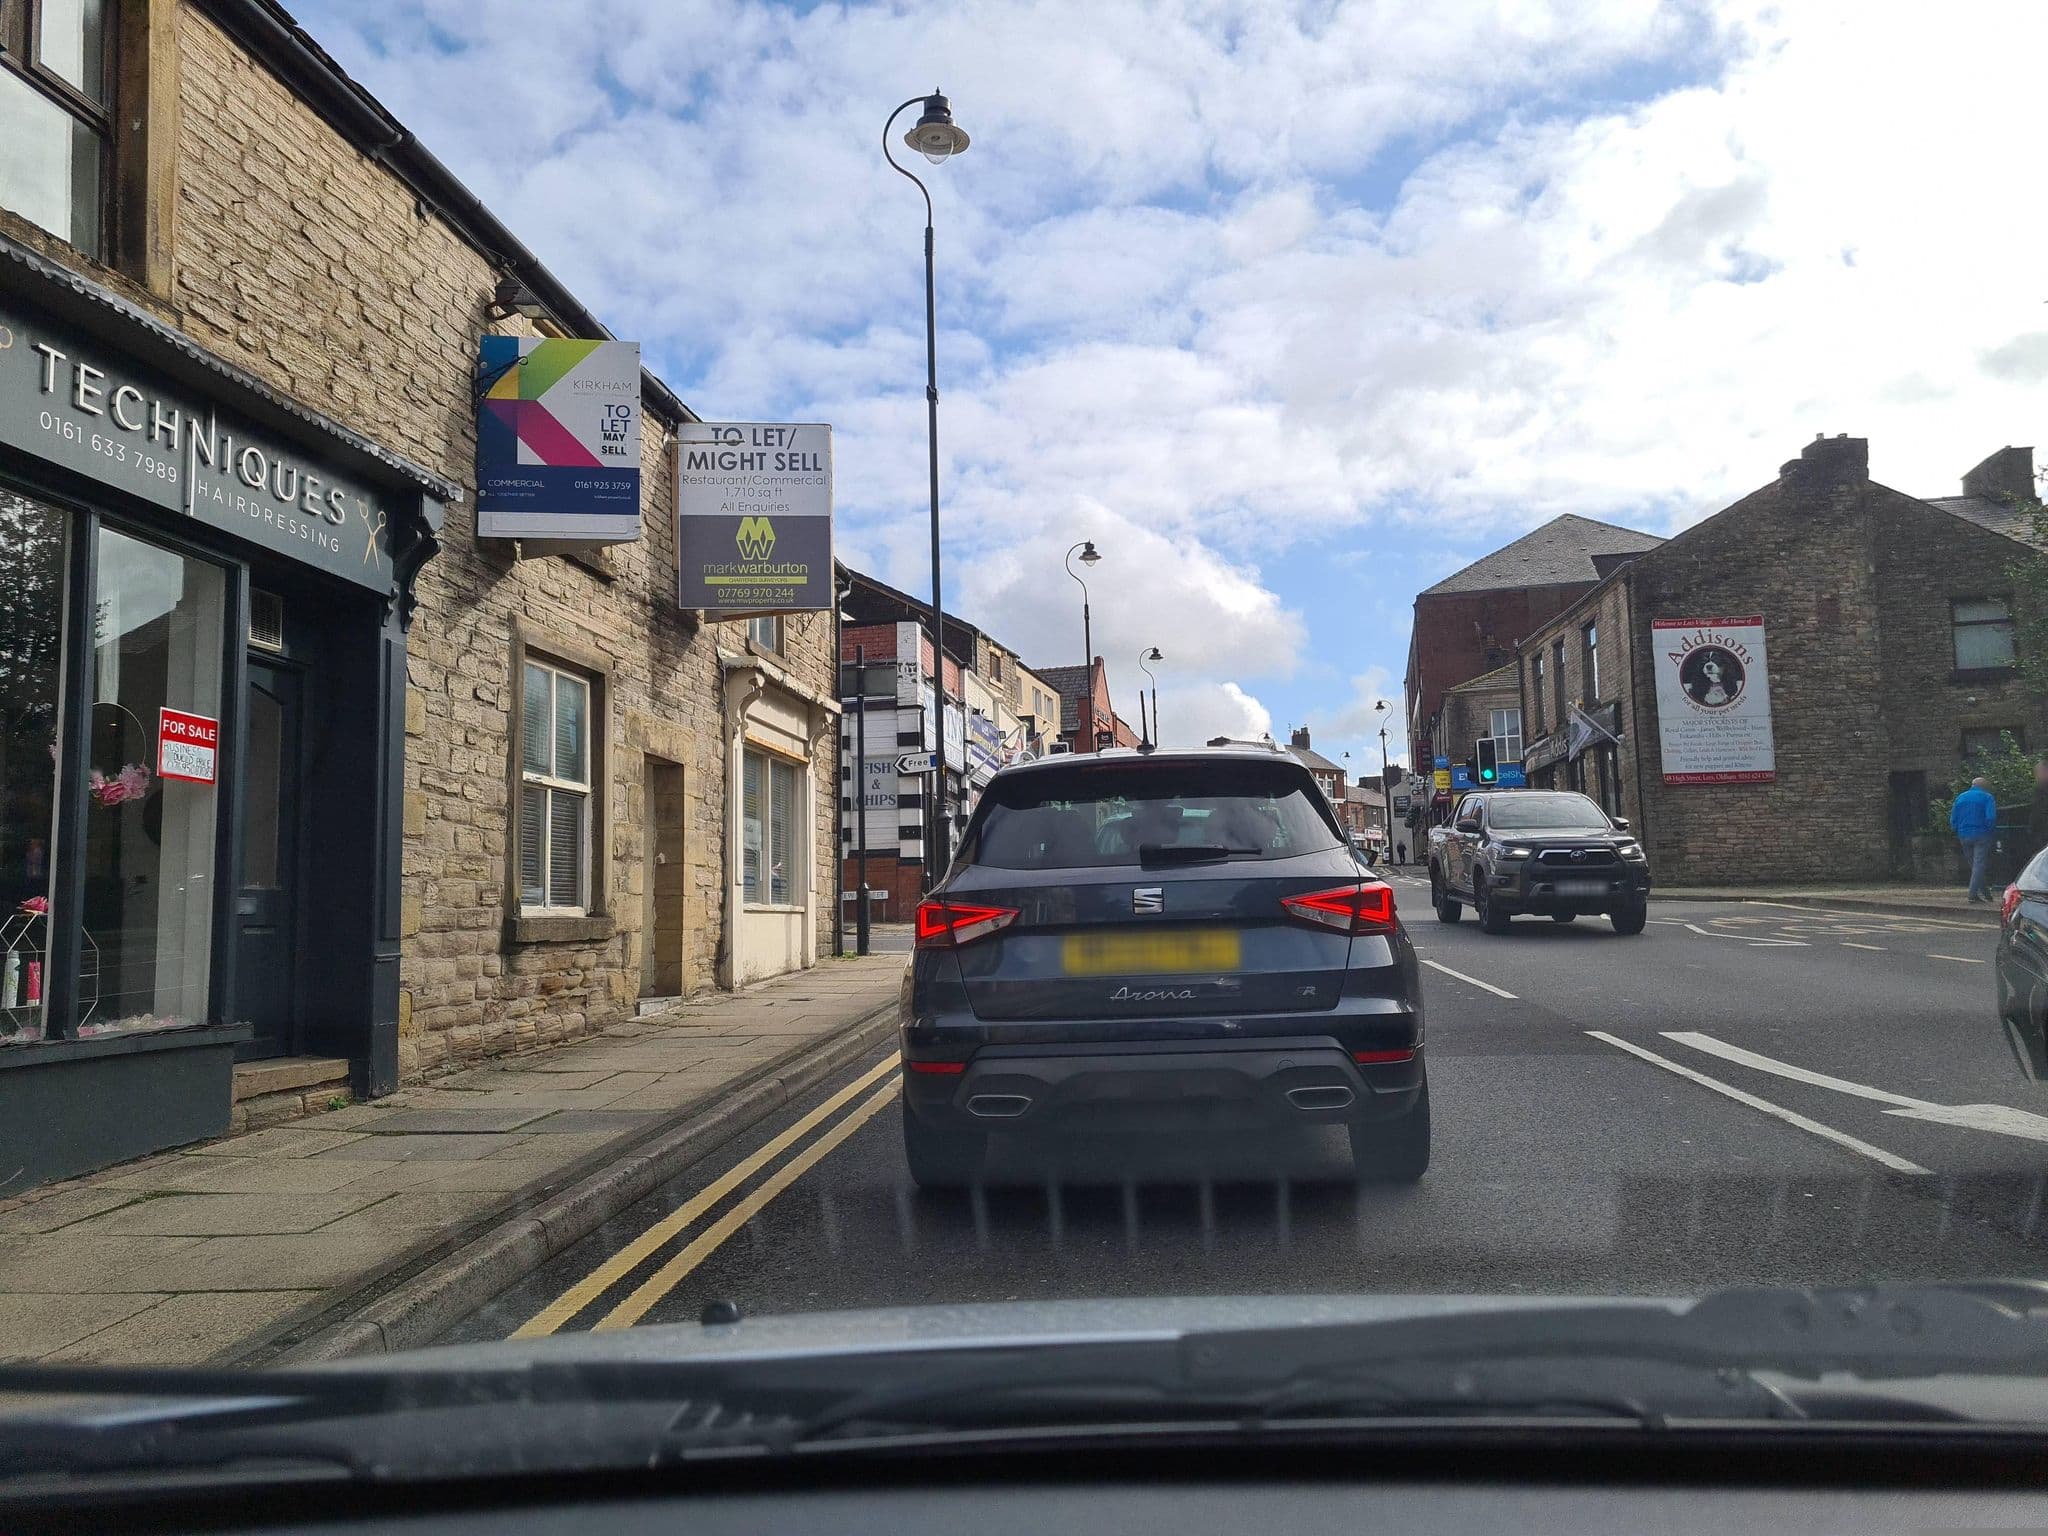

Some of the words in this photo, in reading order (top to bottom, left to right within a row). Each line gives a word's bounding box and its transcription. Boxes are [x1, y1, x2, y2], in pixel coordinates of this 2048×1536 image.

[573, 380, 632, 391] KIRKHAM
[604, 404, 631, 418] TO
[601, 418, 631, 433] LET
[38, 342, 345, 524] TECHNIQUES
[603, 433, 626, 442] MAY
[711, 427, 743, 446] TO
[752, 428, 797, 450] LET/
[40, 411, 82, 444] 0161
[91, 434, 126, 462] 633
[134, 451, 177, 483] 7989
[601, 445, 627, 455] SELL
[686, 451, 767, 471] MIGHT
[774, 453, 823, 471] SELL
[487, 479, 545, 488] COMMERCIAL
[574, 480, 592, 489] 0161
[594, 481, 610, 490] 925
[612, 481, 631, 490] 3759
[682, 475, 826, 486] Restaurant/Commercial
[758, 488, 771, 498] sq
[775, 488, 783, 497] ft
[720, 502, 735, 512] All
[738, 502, 790, 513] Enquiries
[198, 479, 340, 553] HAIRDRESSING
[703, 562, 808, 574] markwarburton
[717, 588, 750, 598] 07769
[752, 588, 773, 598] 970
[775, 588, 794, 598] 244
[1668, 629, 1754, 667] Addisons
[162, 719, 186, 736] FOR
[188, 724, 216, 742] SALE
[908, 759, 928, 767] Free
[871, 778, 881, 790] &
[857, 794, 897, 806] HIPS
[1109, 986, 1197, 1001] Arona
